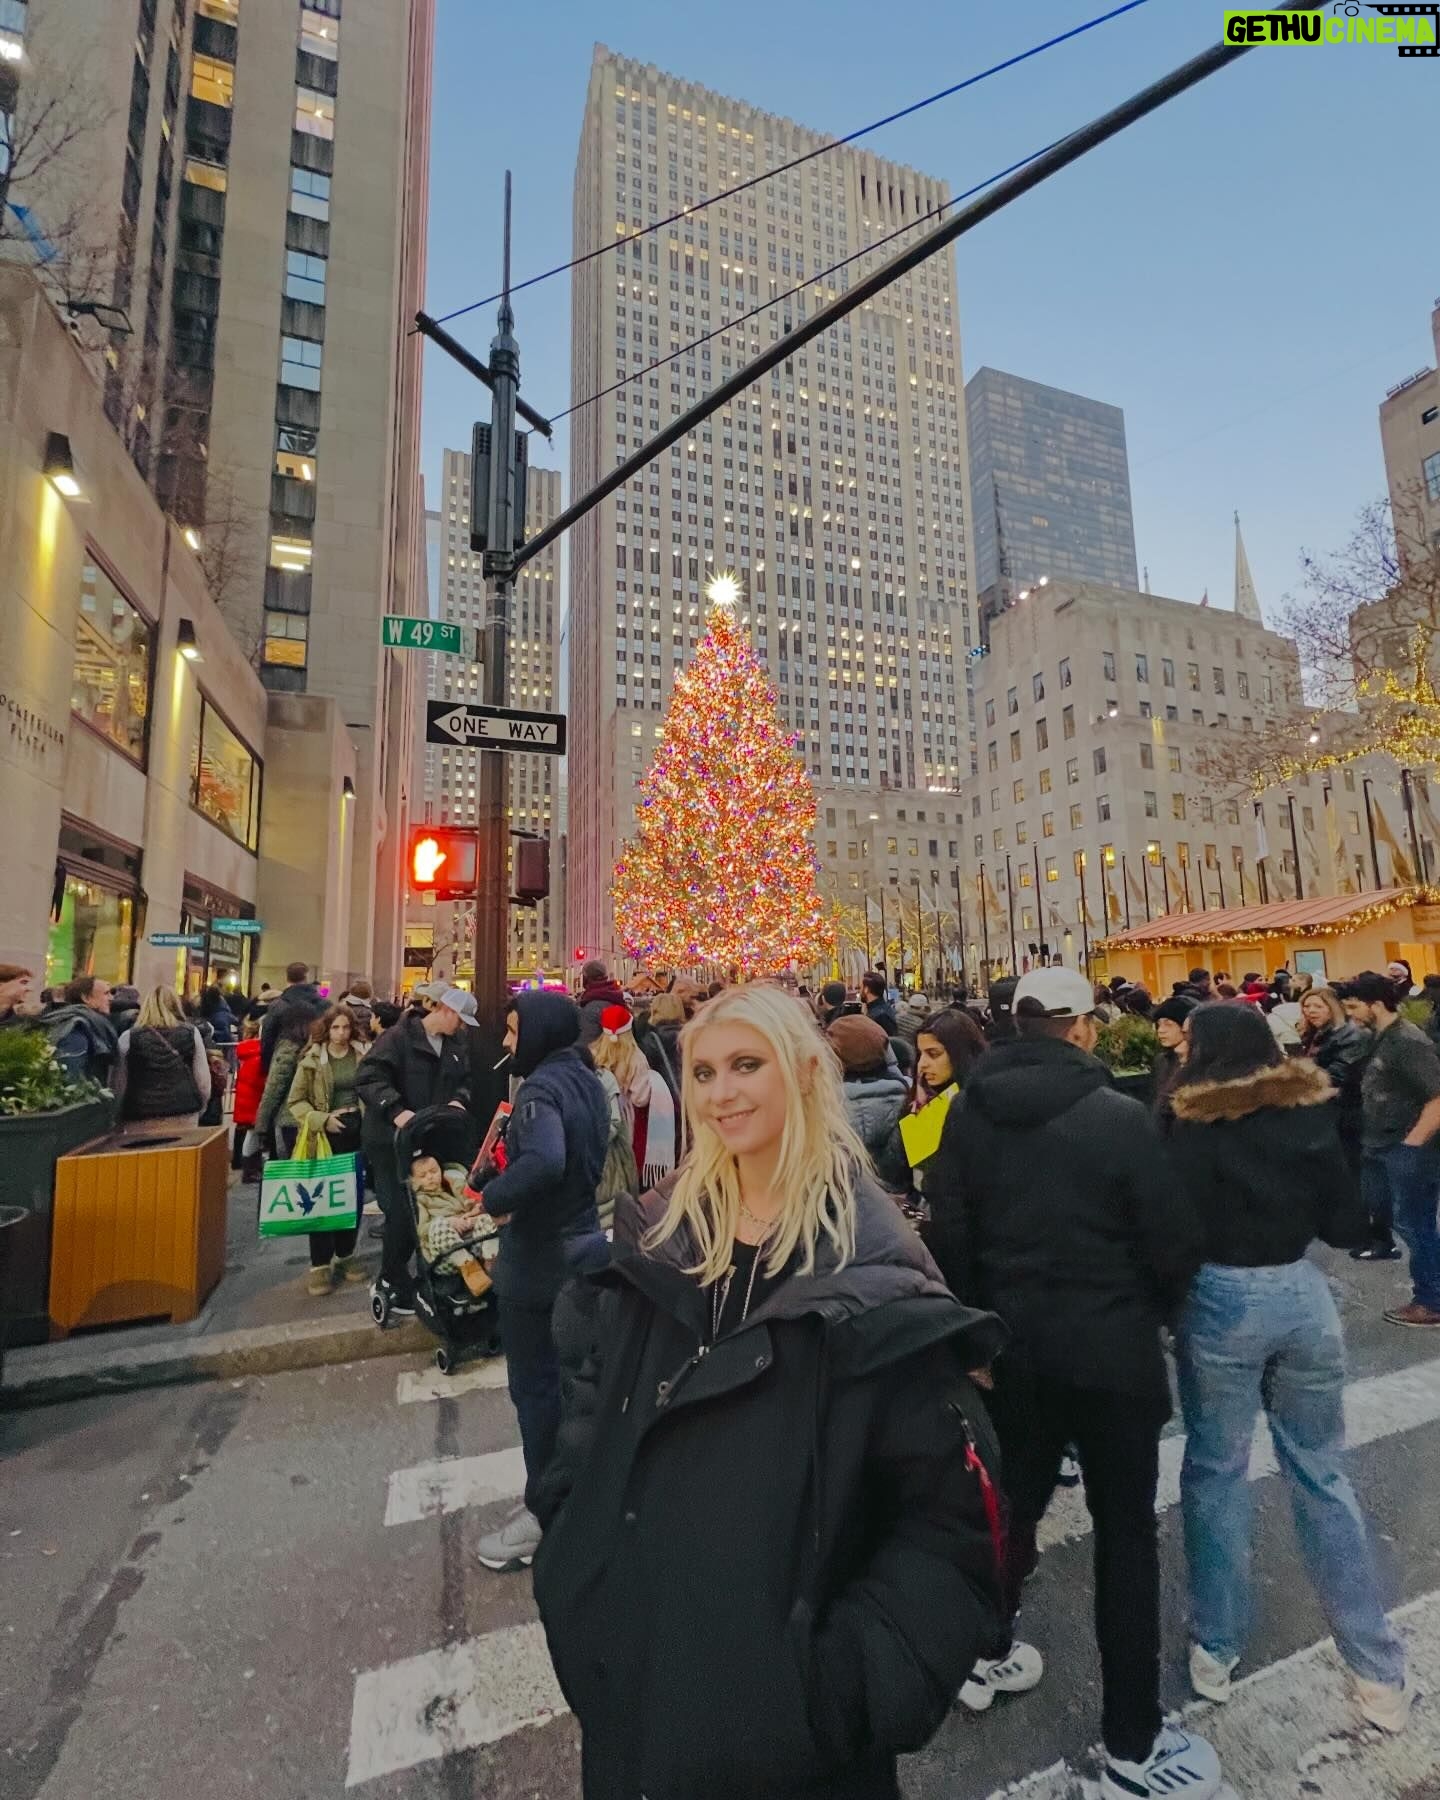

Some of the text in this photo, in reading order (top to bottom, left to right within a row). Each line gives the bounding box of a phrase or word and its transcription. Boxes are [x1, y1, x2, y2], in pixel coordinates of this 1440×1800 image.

[388, 619, 456, 646] W 49 ST
[0, 694, 64, 745] OCKEFELLER
[449, 715, 549, 741] ONE WAY
[10, 722, 46, 753] PLAZA
